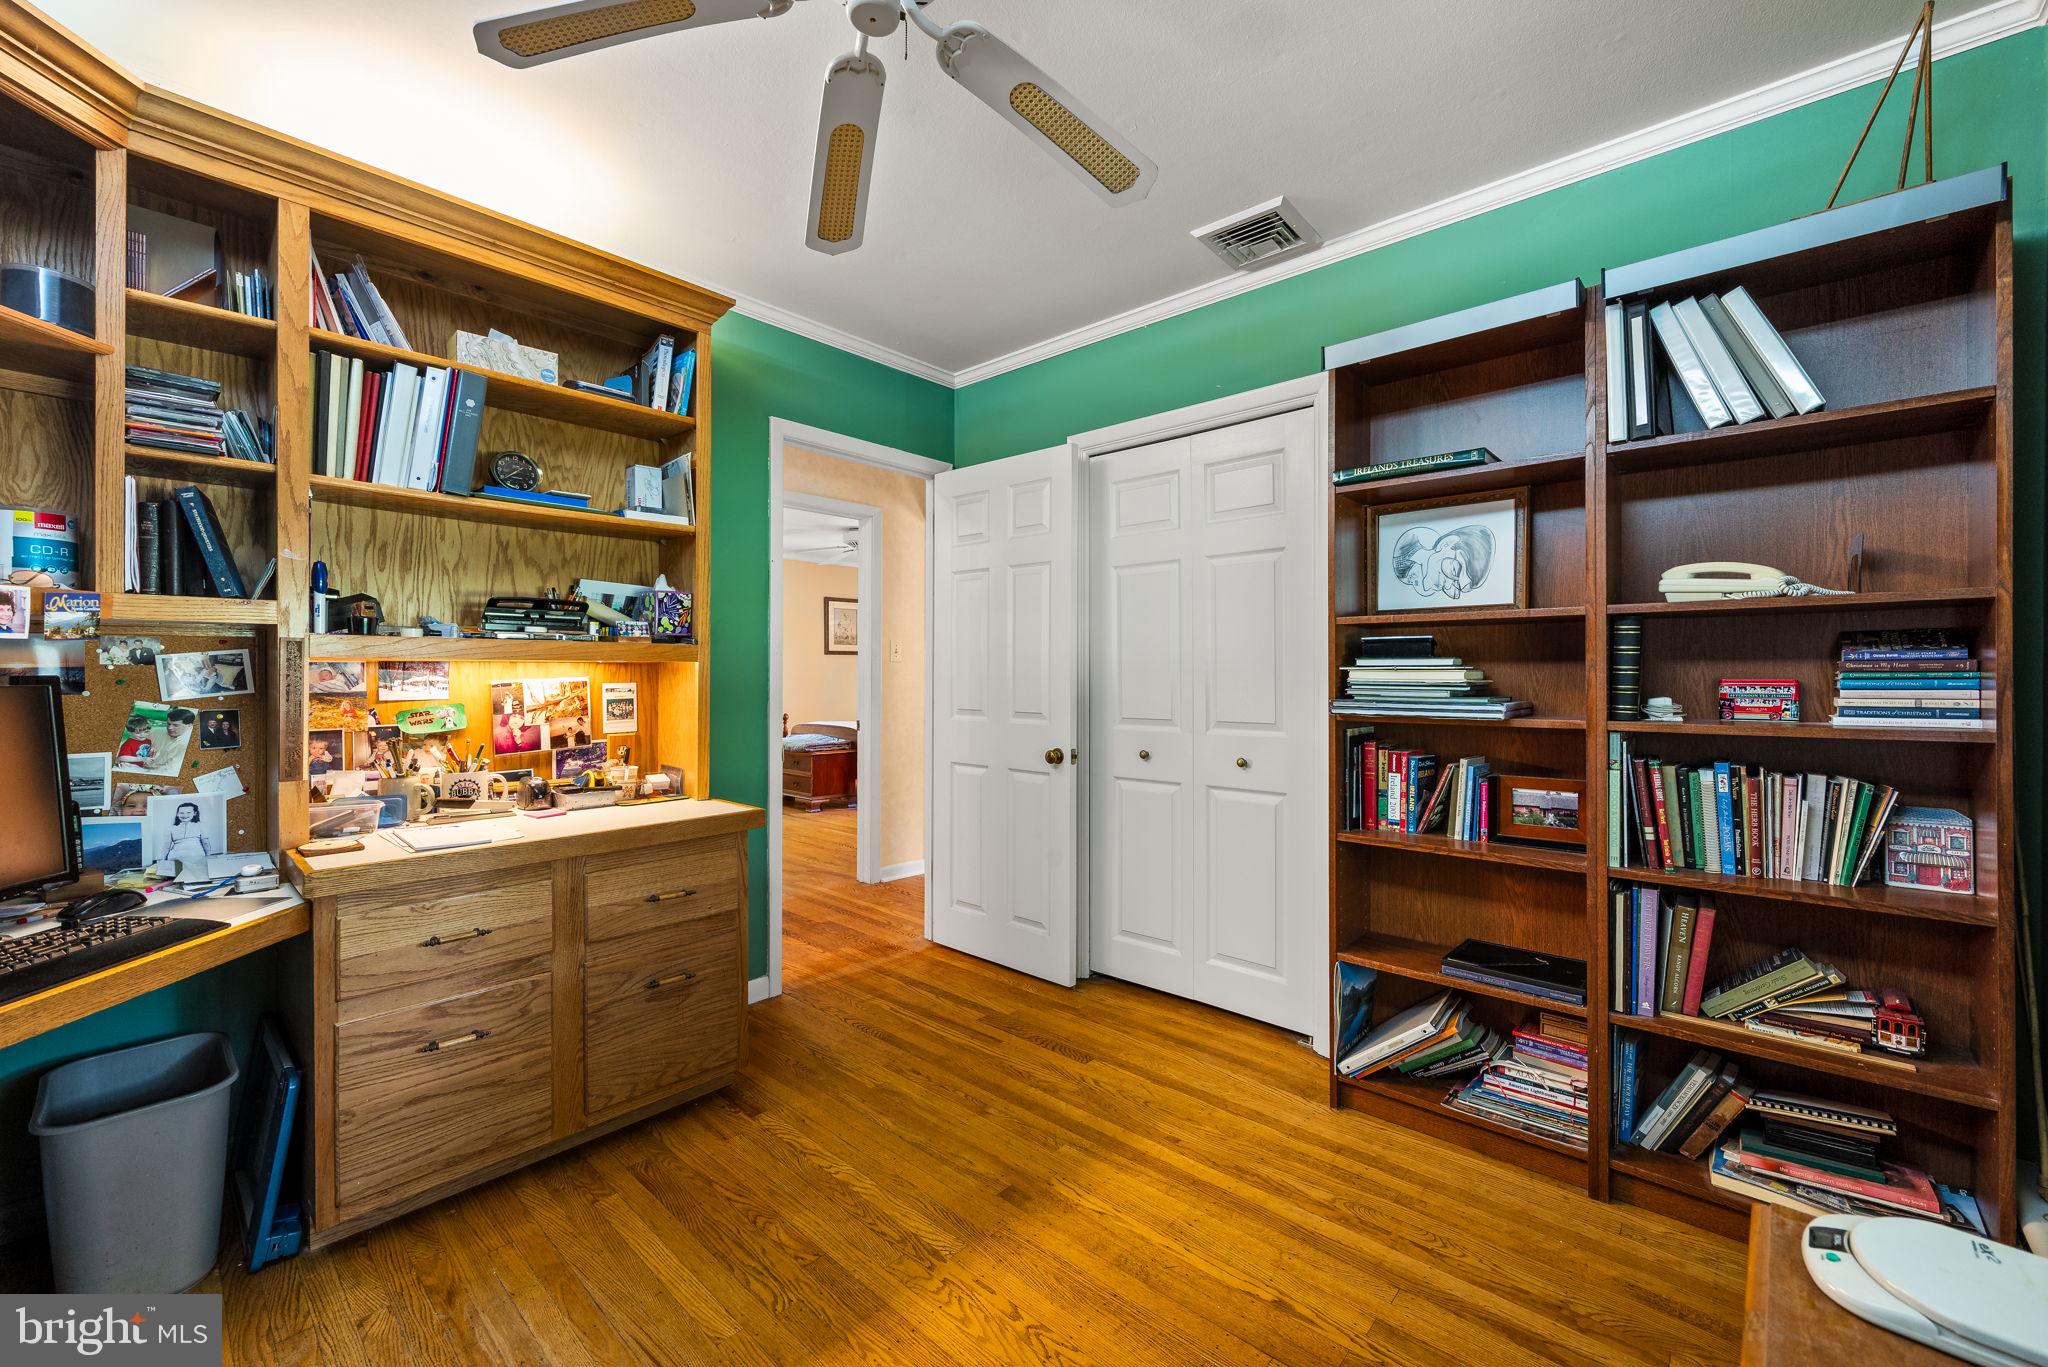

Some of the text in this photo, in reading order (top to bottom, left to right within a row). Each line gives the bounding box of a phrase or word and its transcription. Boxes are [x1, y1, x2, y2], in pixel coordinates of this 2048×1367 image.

[1400, 452, 1454, 469] TREASURES
[37, 522, 65, 531] maxell
[30, 544, 69, 557] CD-R
[45, 594, 100, 614] Marion
[408, 710, 434, 718] STAR
[408, 718, 434, 726] WARS
[451, 788, 480, 798] BUBBA
[1723, 826, 1732, 852] POEMS
[1678, 912, 1690, 944] HEAVEN
[1642, 930, 1652, 970] FLOWERS
[1672, 972, 1682, 994] ALCORN
[1742, 975, 1788, 996] Shade Gardening
[1777, 980, 1830, 1002] BREAKFAST WITH JESUS
[1508, 1082, 1558, 1100] American Lighthouses
[1789, 1168, 1814, 1179] essential
[1814, 1174, 1835, 1184] dessert
[1836, 1180, 1863, 1192] cookbook
[1911, 1200, 1927, 1208] books
